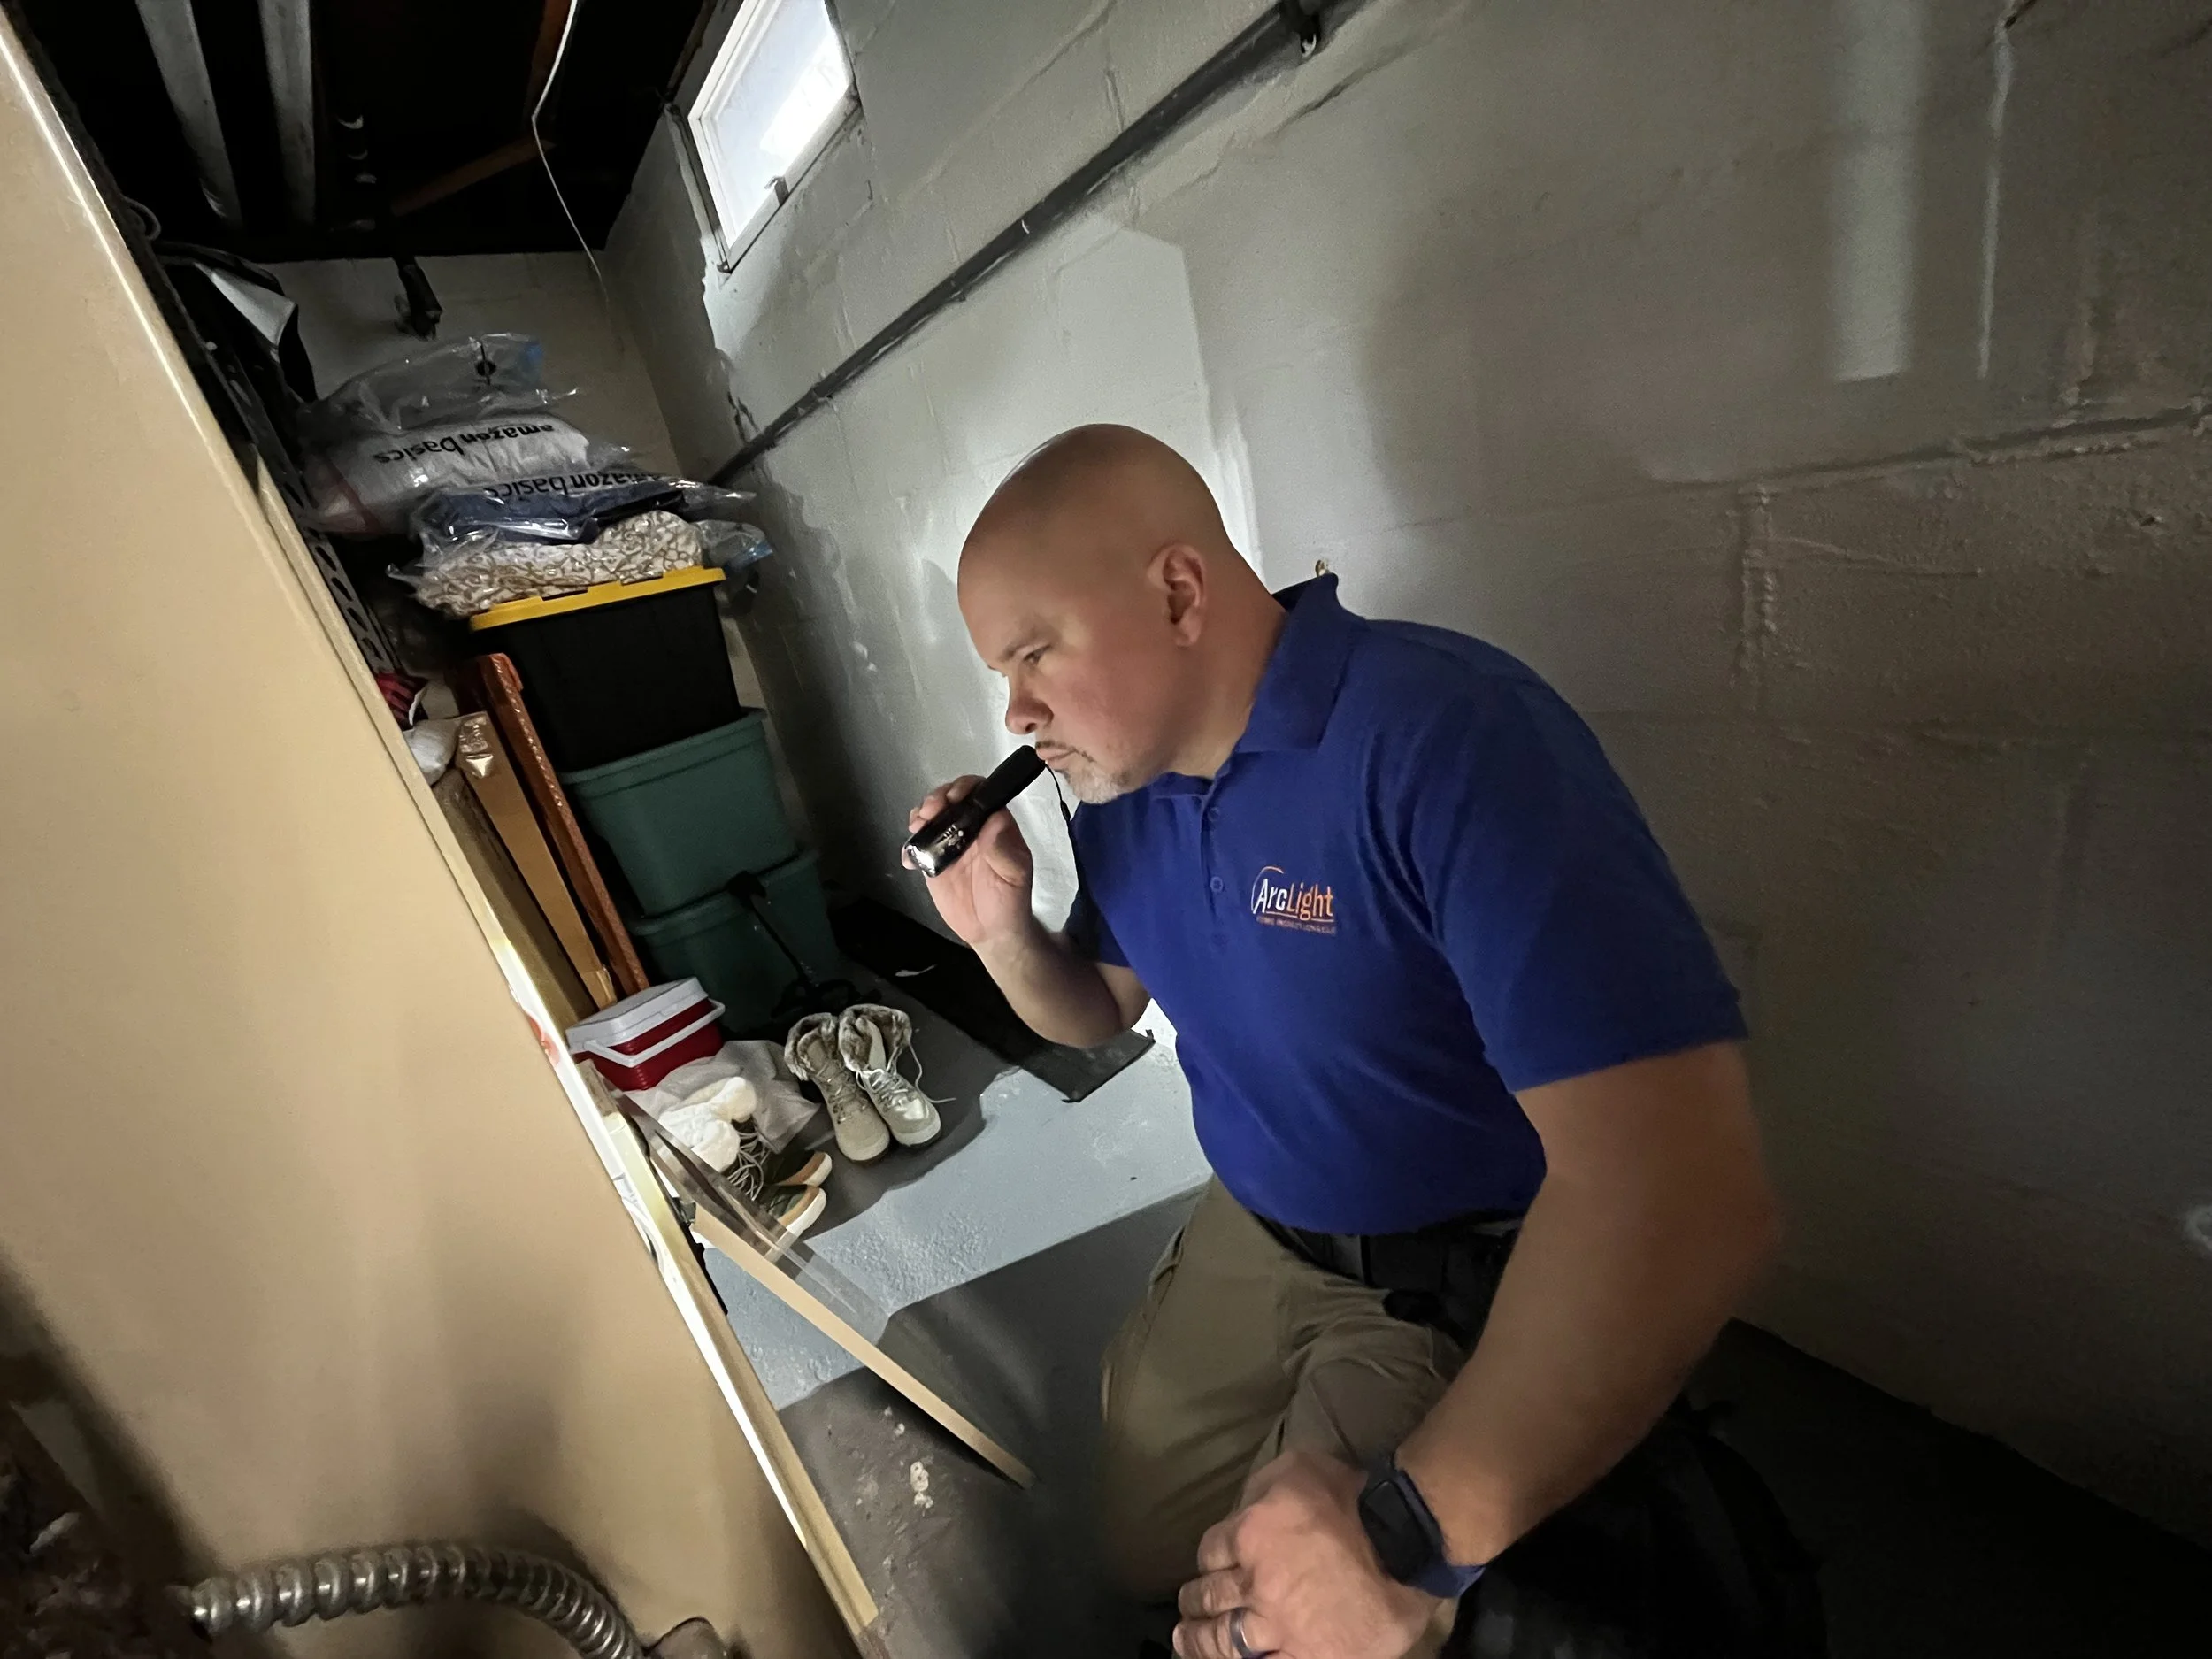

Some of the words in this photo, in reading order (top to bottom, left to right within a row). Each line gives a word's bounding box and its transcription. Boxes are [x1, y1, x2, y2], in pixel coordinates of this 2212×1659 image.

[459, 425, 554, 443] amazon
[373, 436, 465, 463] basics
[1253, 878, 1333, 920] ArcLight
